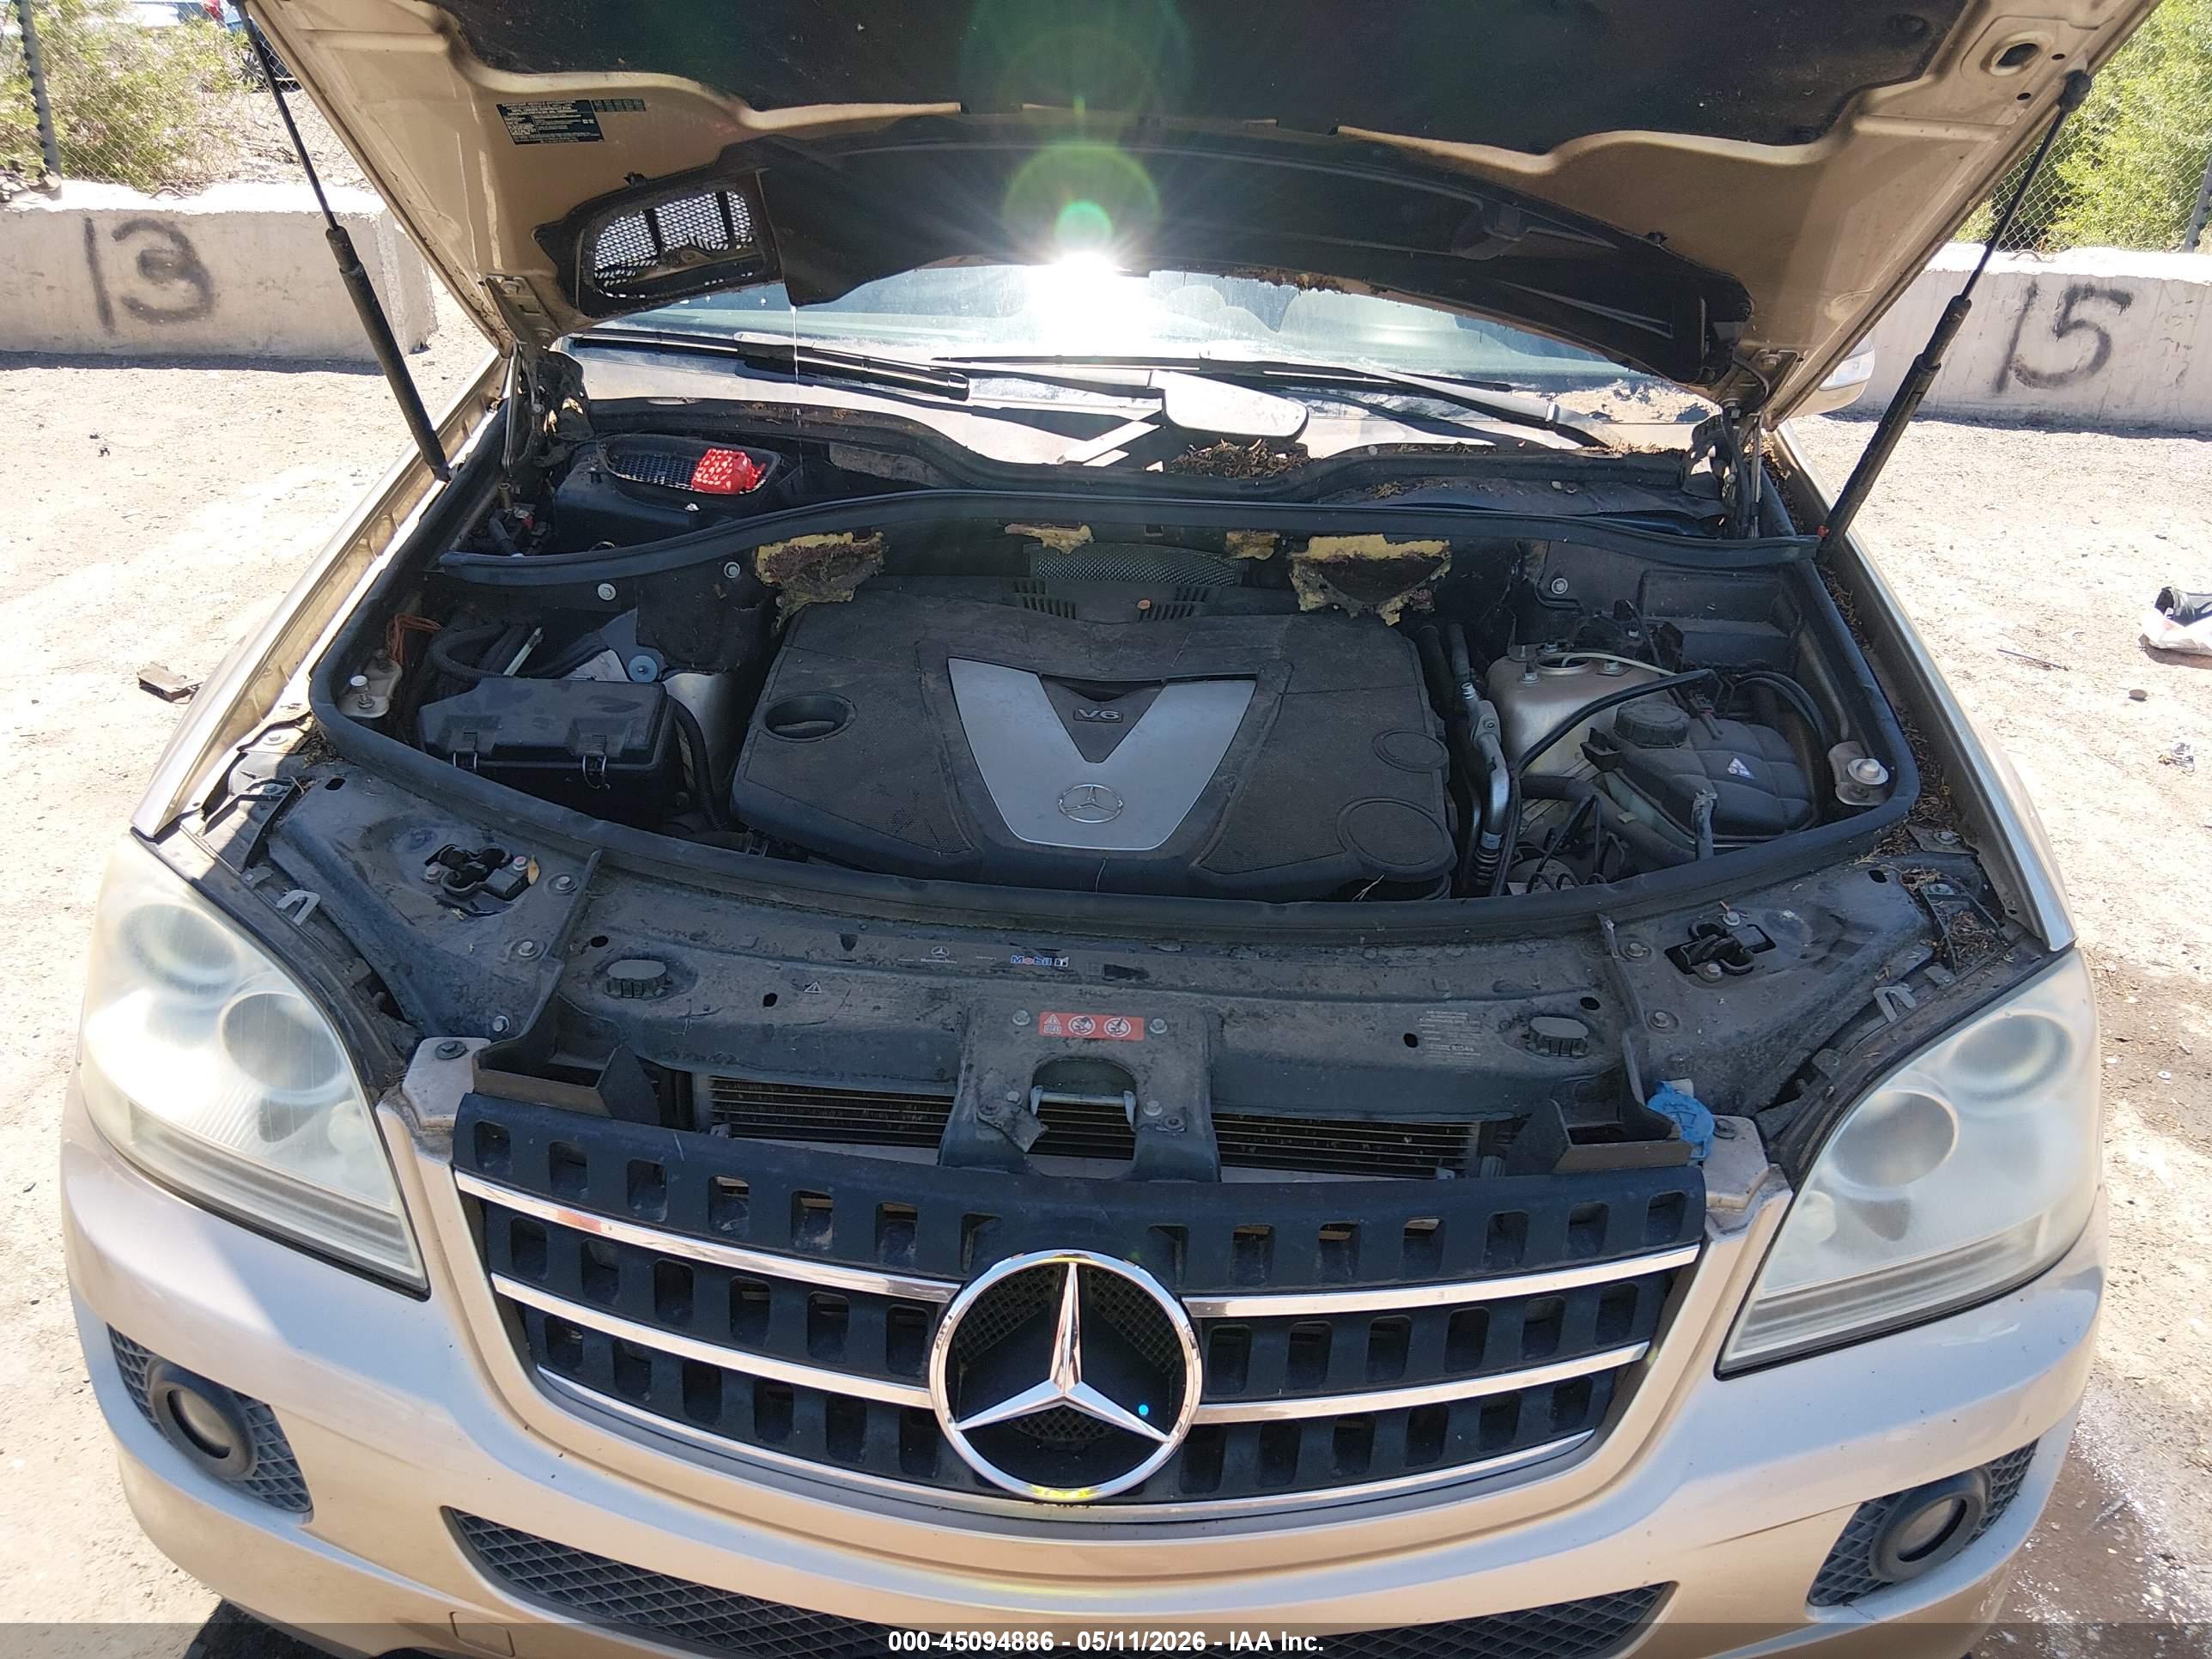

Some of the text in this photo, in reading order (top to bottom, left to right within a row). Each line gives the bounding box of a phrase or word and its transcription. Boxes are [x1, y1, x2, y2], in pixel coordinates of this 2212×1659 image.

[84, 217, 216, 336] 13
[1993, 281, 2133, 393] 15
[1078, 708, 1120, 720] V6
[1010, 955, 1053, 966] Mobil
